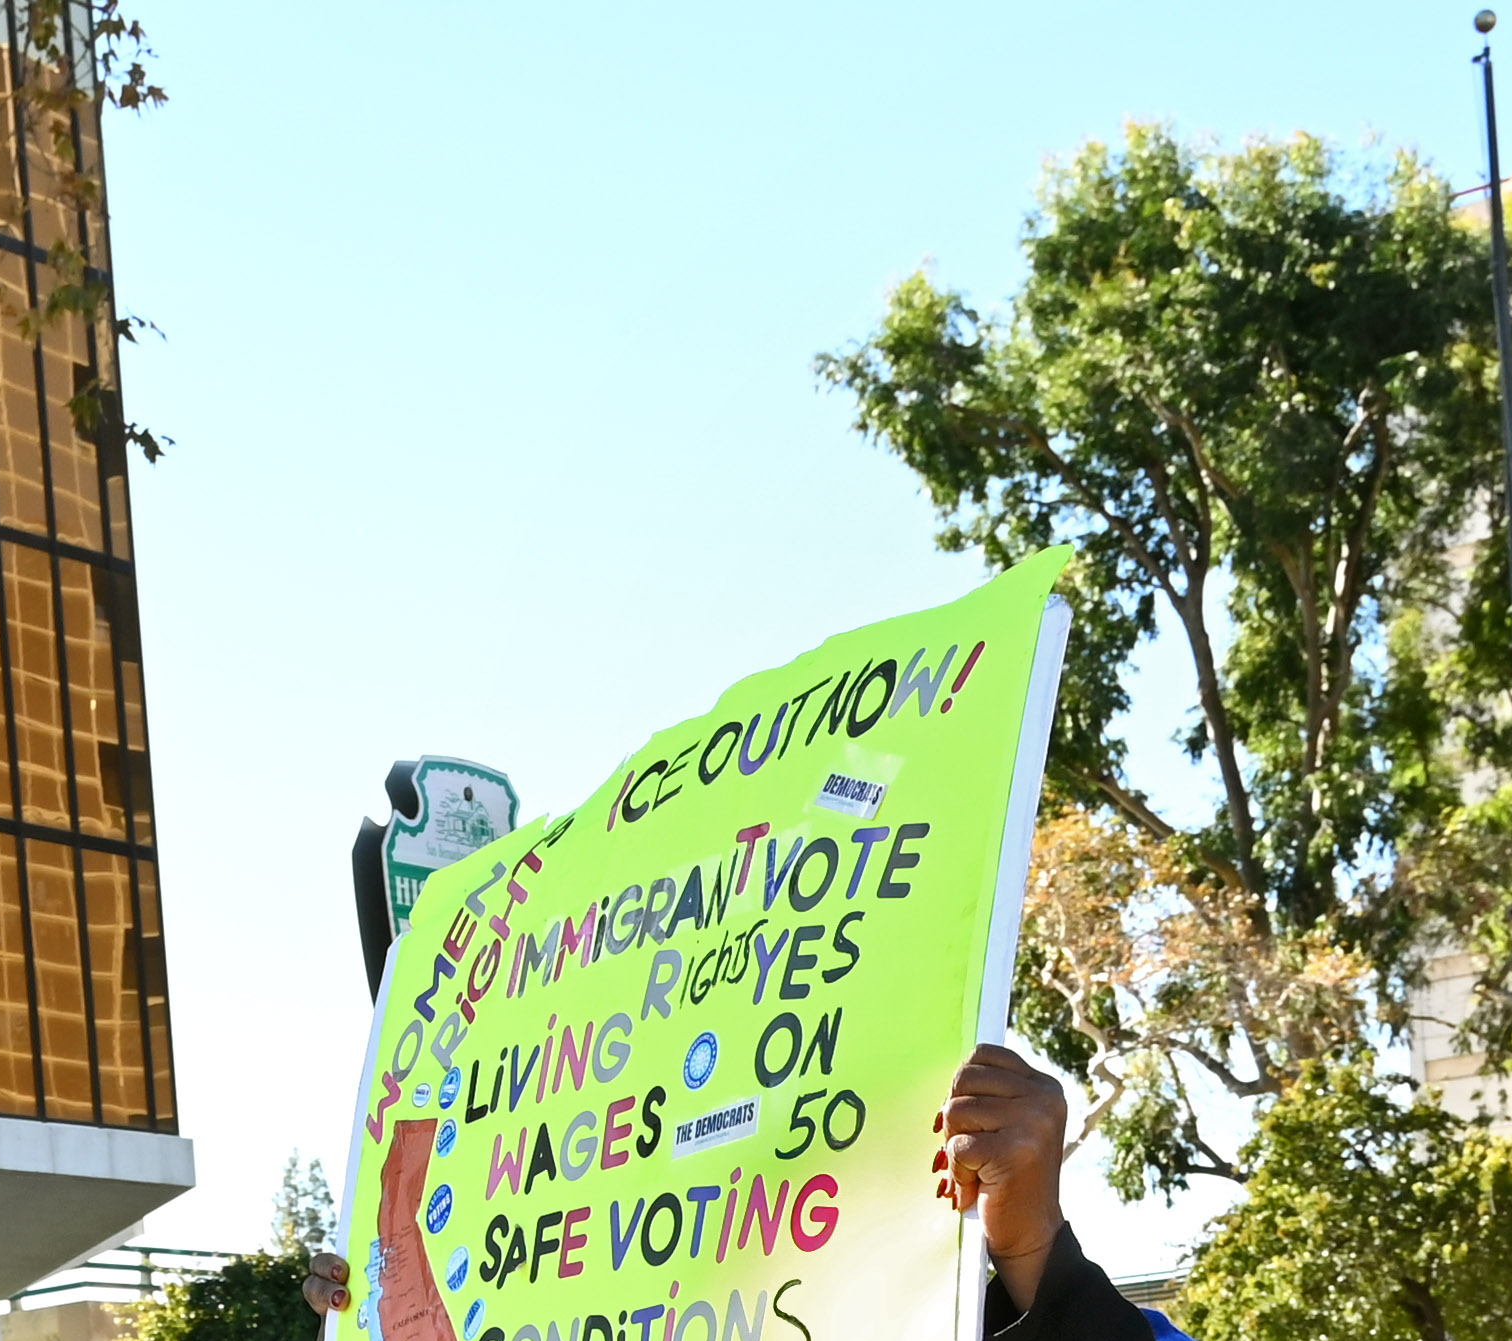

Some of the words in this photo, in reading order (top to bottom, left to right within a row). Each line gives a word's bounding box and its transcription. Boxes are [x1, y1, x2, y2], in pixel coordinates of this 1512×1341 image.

[607, 739, 702, 833] ICE
[698, 676, 833, 786] OUT
[805, 640, 986, 747] NOW!
[764, 822, 932, 914] VOTE
[366, 860, 508, 1145] WOMEN
[753, 910, 866, 1006] YES
[754, 1007, 843, 1089] ON
[487, 1085, 666, 1202] WAGES
[675, 1121, 694, 1146] THE
[694, 1102, 755, 1139] DEMOCRATS
[775, 1088, 866, 1161] 50
[479, 1204, 590, 1290] SAFE
